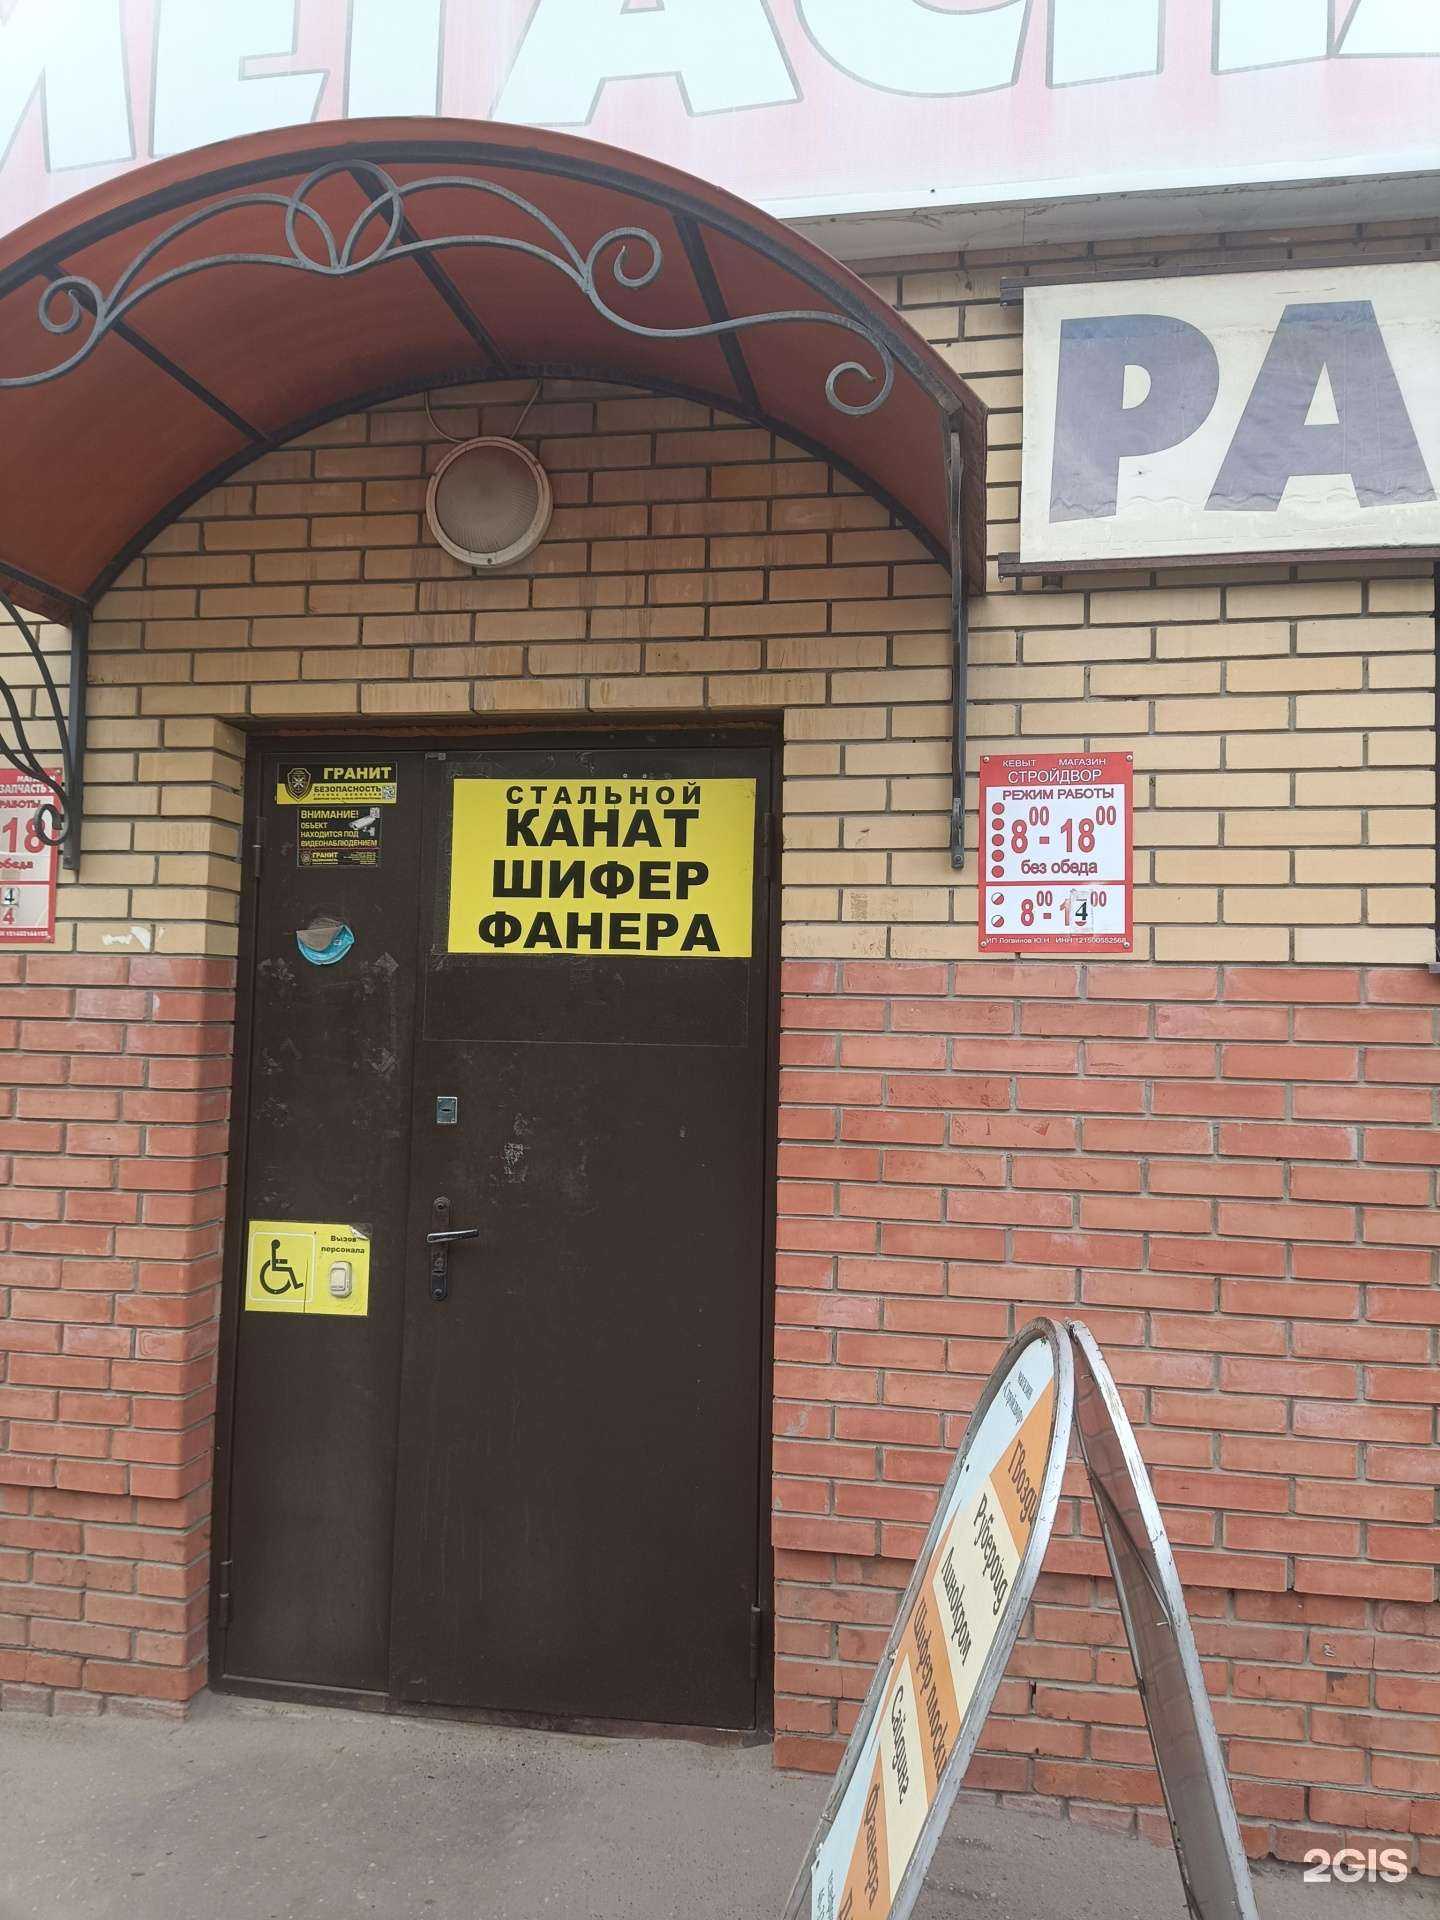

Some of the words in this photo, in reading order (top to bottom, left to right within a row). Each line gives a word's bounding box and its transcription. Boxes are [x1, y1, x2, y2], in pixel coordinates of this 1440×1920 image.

[1002, 759, 1037, 767] КЕВЫТ
[1058, 758, 1106, 766] МАГАЗИН
[323, 767, 392, 780] ГРАНИТ
[1008, 768, 1102, 784] СТРОЙДВОР
[314, 785, 381, 793] БЕЗОПАСНОСТЬ
[506, 781, 701, 805] СТАЛЬНОЙ
[1002, 789, 1054, 801] РЕЖИМ
[1057, 788, 1115, 800] РАБОТЫ
[300, 810, 359, 819] ВНИМАНИЕ!
[343, 831, 359, 839] ПОД
[505, 808, 700, 848] КАНАТ
[300, 840, 378, 848] ВИДЕОНАБЛЮДЕНИЕМ
[1020, 860, 1047, 875] без
[1051, 858, 1098, 876] обеда
[492, 859, 710, 900] ШИФЕР
[478, 910, 721, 952] ФАНЕРА
[321, 1246, 365, 1254] персонала
[973, 1492, 1009, 1616] Рубероид
[940, 1546, 972, 1667] Линокром
[913, 1596, 933, 1696] Шифер
[891, 1685, 909, 1806] Сайдинг
[863, 1783, 880, 1911] Фанера
